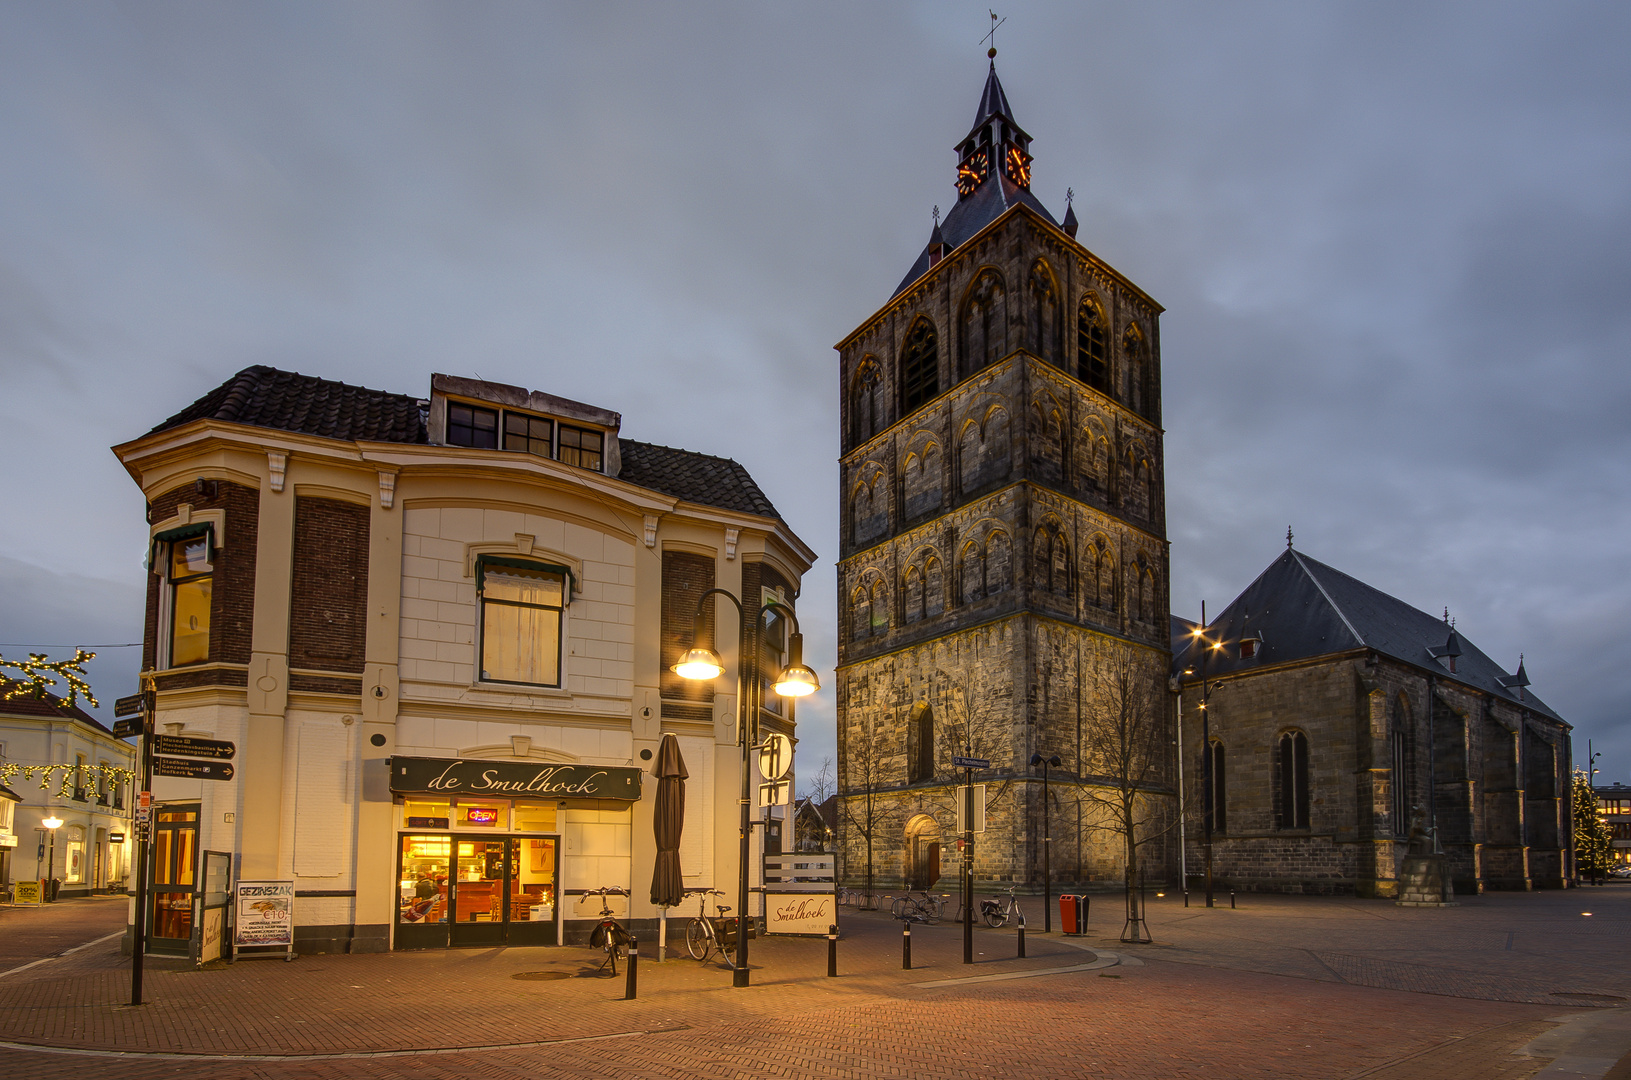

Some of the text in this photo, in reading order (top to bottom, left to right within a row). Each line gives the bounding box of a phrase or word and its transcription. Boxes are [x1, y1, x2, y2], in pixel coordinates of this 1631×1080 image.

[163, 743, 216, 751] Plechelmusbasiliek
[428, 761, 608, 794] de Smulhoek
[469, 811, 496, 821] OPEN
[240, 886, 292, 896] GEZINSZAK
[773, 898, 830, 922] Smulhoek
[786, 900, 796, 912] de
